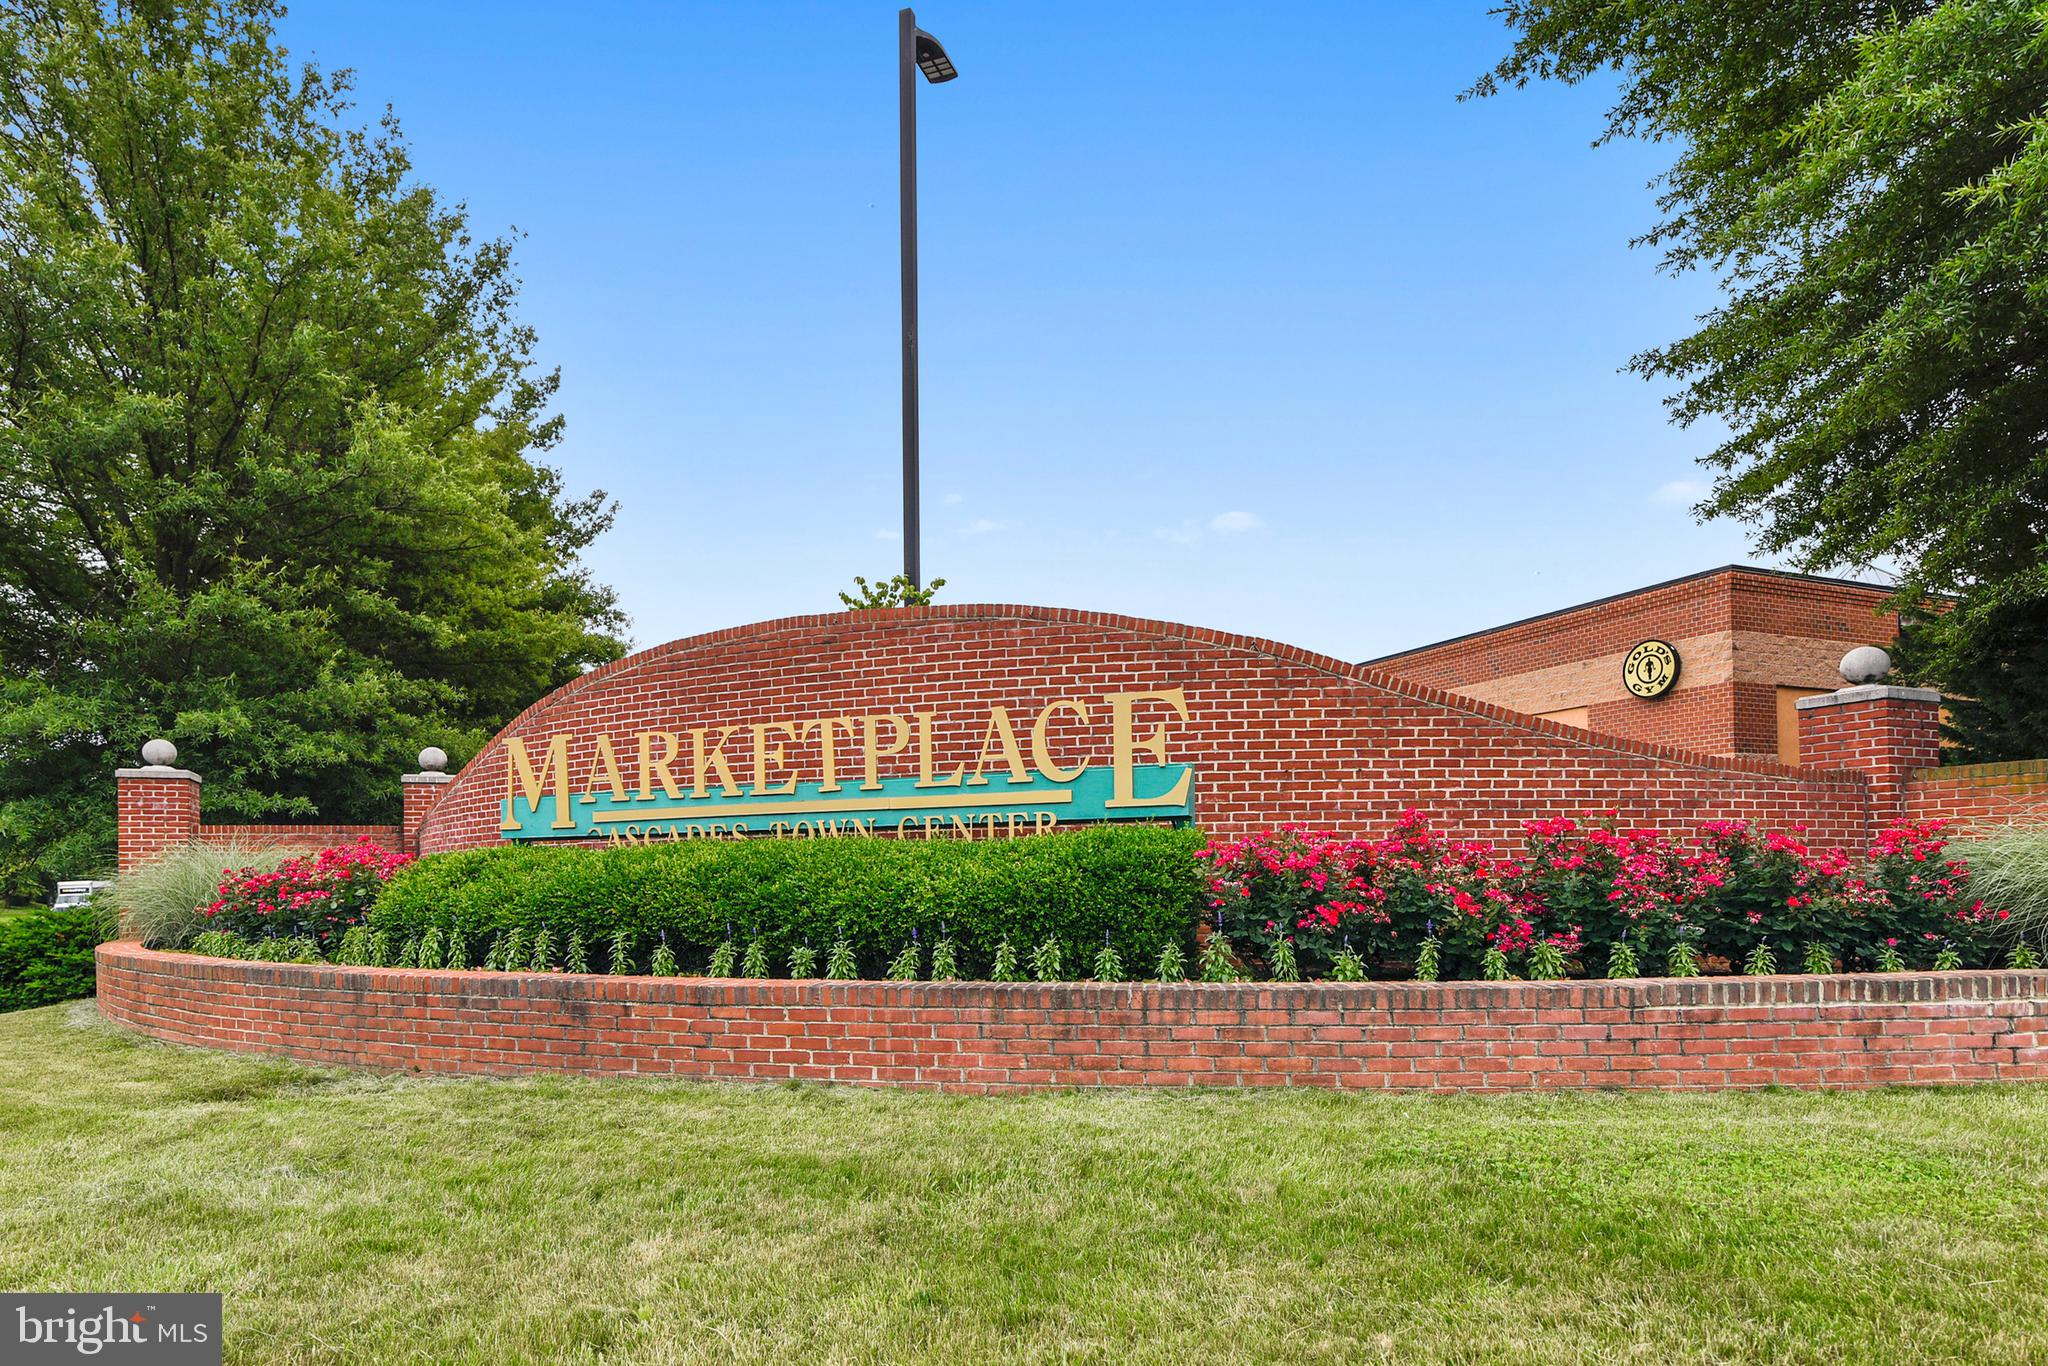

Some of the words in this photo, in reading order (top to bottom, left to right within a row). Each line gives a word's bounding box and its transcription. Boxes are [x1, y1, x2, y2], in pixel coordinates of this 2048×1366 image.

[1628, 646, 1672, 674] GOLD'S
[1632, 674, 1669, 694] GYM
[500, 687, 1193, 831] MARKETPLACE
[768, 818, 875, 840] TOWN
[897, 811, 1058, 843] CENTER
